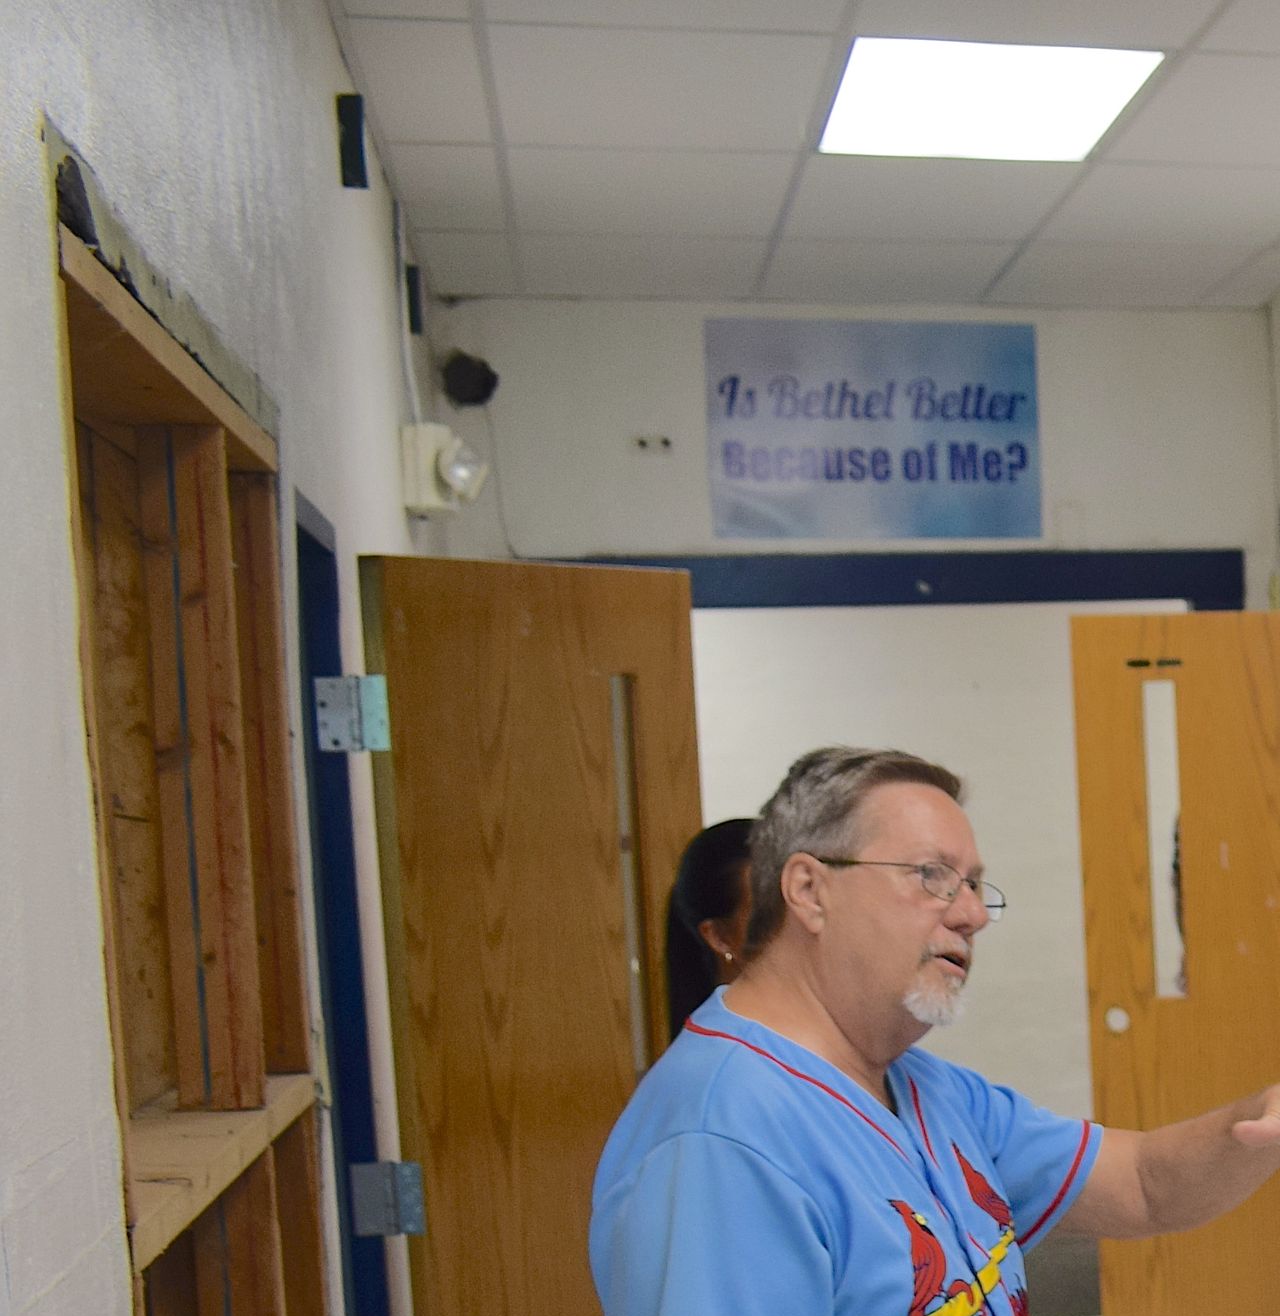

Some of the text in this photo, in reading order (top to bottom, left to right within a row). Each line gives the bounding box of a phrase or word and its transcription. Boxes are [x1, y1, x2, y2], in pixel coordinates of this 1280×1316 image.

[718, 374, 1028, 422] Is Bethel Better
[721, 441, 1029, 483] Because of Me?
